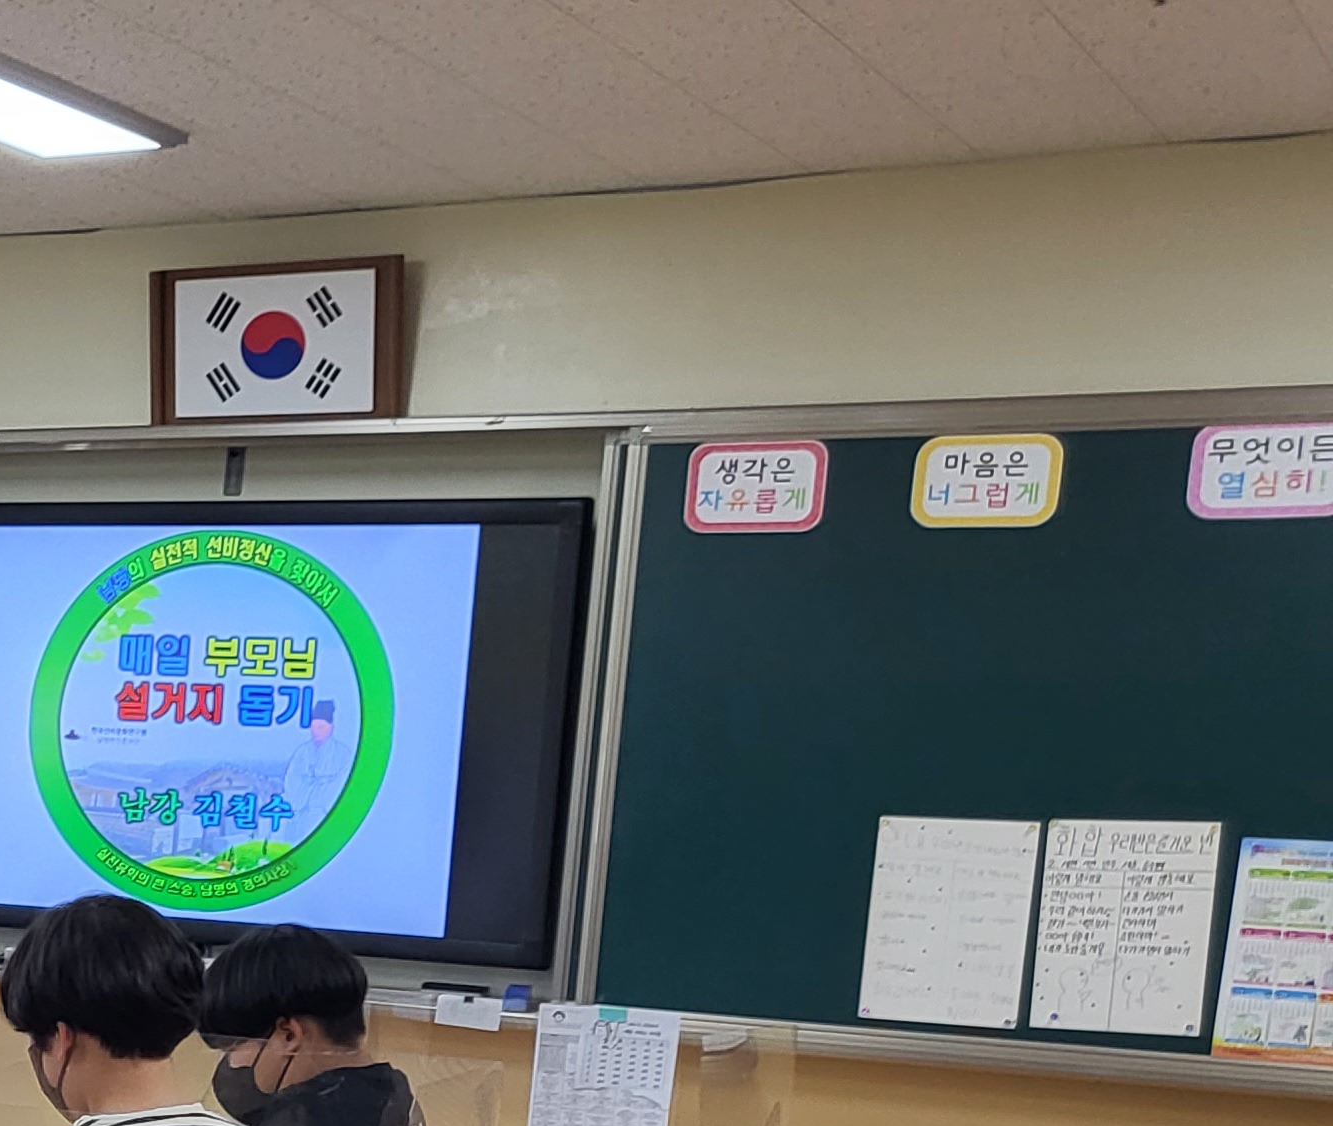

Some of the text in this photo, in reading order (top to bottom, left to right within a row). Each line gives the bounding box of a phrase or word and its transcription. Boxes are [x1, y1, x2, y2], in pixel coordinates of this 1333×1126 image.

[944, 451, 1030, 479] 마음은
[1208, 435, 1333, 466] 무엇이든
[715, 457, 795, 485] 생각은
[1218, 470, 1327, 499] 열심히!
[697, 487, 806, 514] 자유롭게
[927, 481, 1040, 508] 너그럽게
[292, 557, 340, 608] 찾아서
[118, 634, 317, 679] 매일 부모님
[116, 681, 314, 728] 설거지 돕기
[118, 788, 294, 832] 남강 김철수
